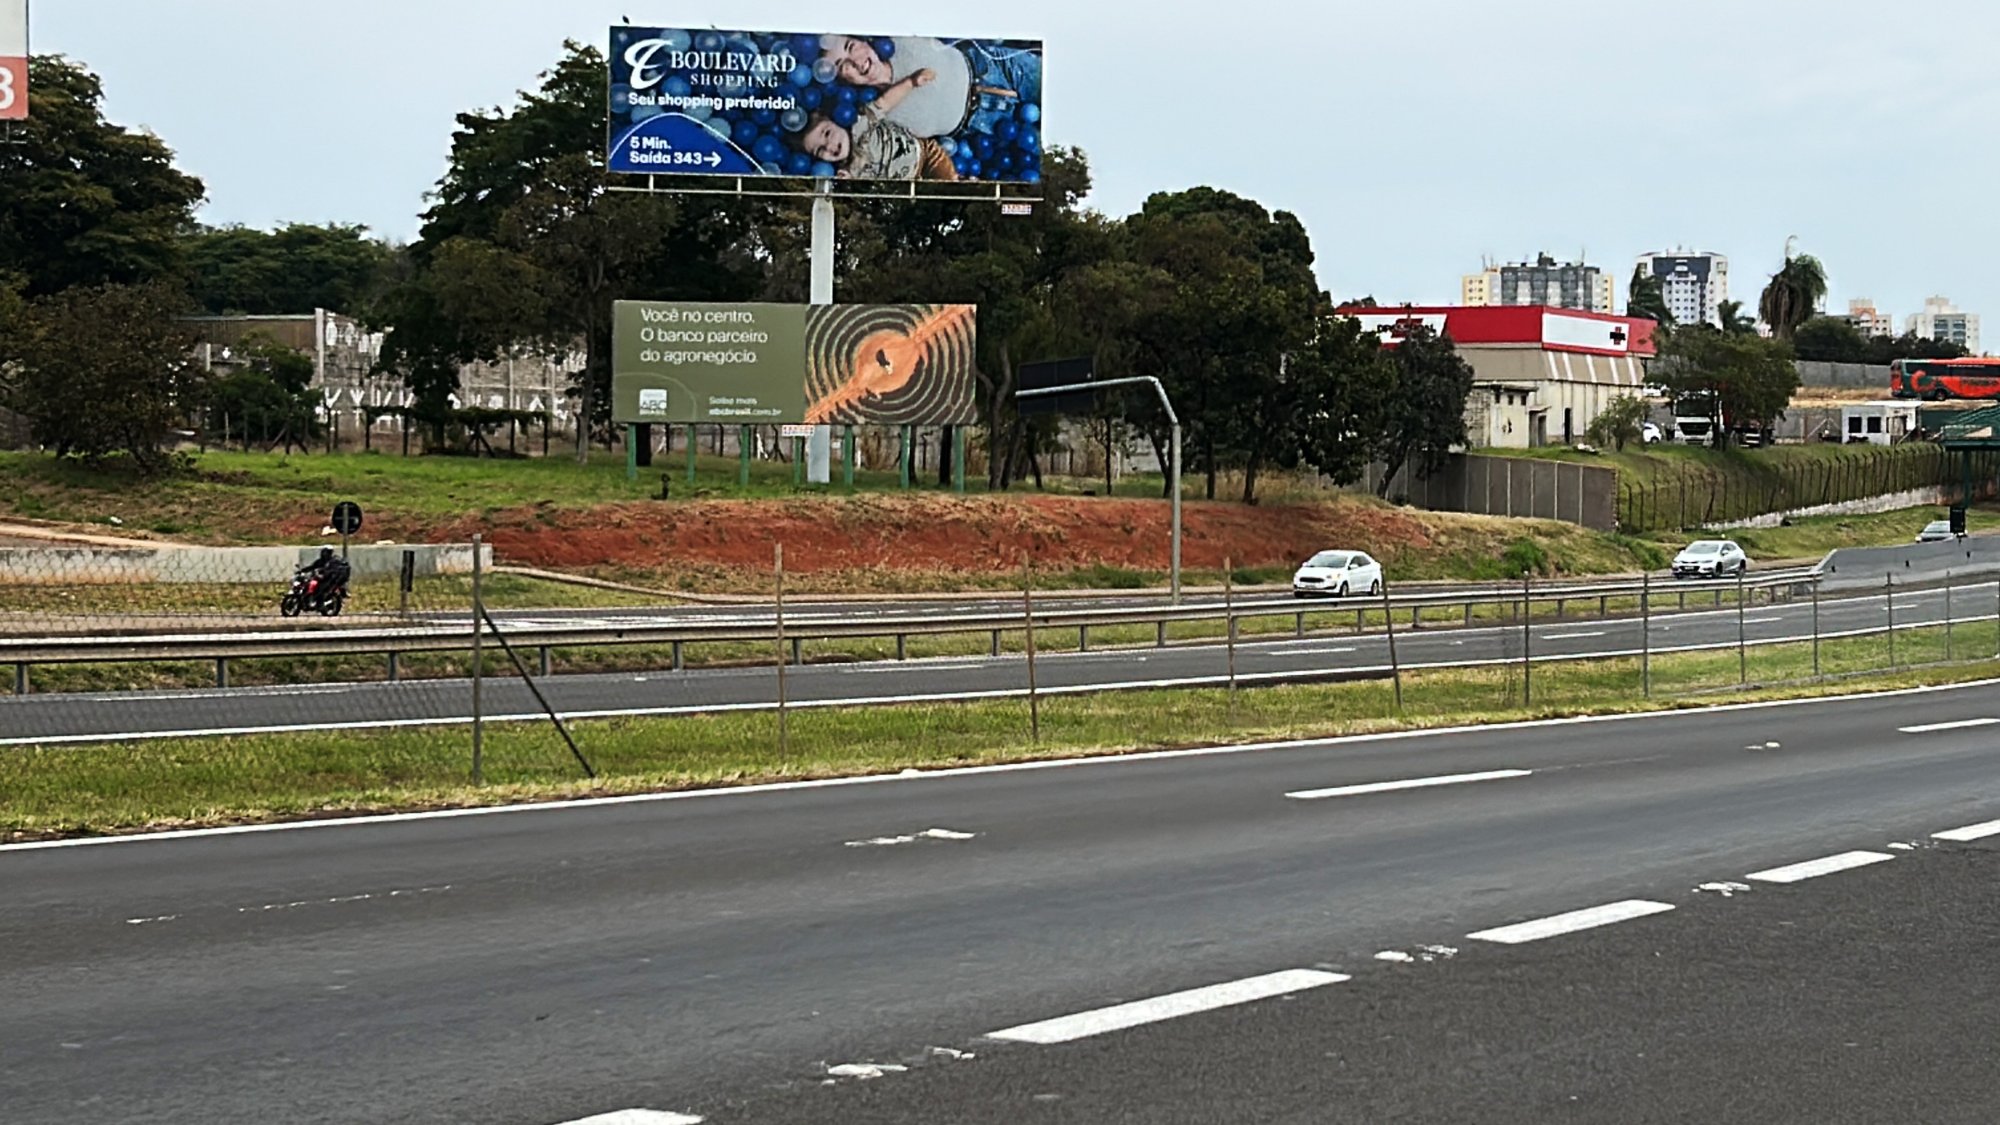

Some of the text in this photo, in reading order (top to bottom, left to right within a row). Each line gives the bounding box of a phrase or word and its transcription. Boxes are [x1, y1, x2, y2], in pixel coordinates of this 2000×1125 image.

[671, 50, 796, 73] BOULEVARD
[690, 73, 778, 88] SHOPPING
[628, 92, 795, 111] Seu shopping preferido!
[630, 136, 672, 149] 5 Min.
[630, 151, 702, 165] Saída 343
[641, 307, 755, 324] Você no centro.
[640, 327, 768, 344] O banco parceiro
[640, 347, 661, 362] do
